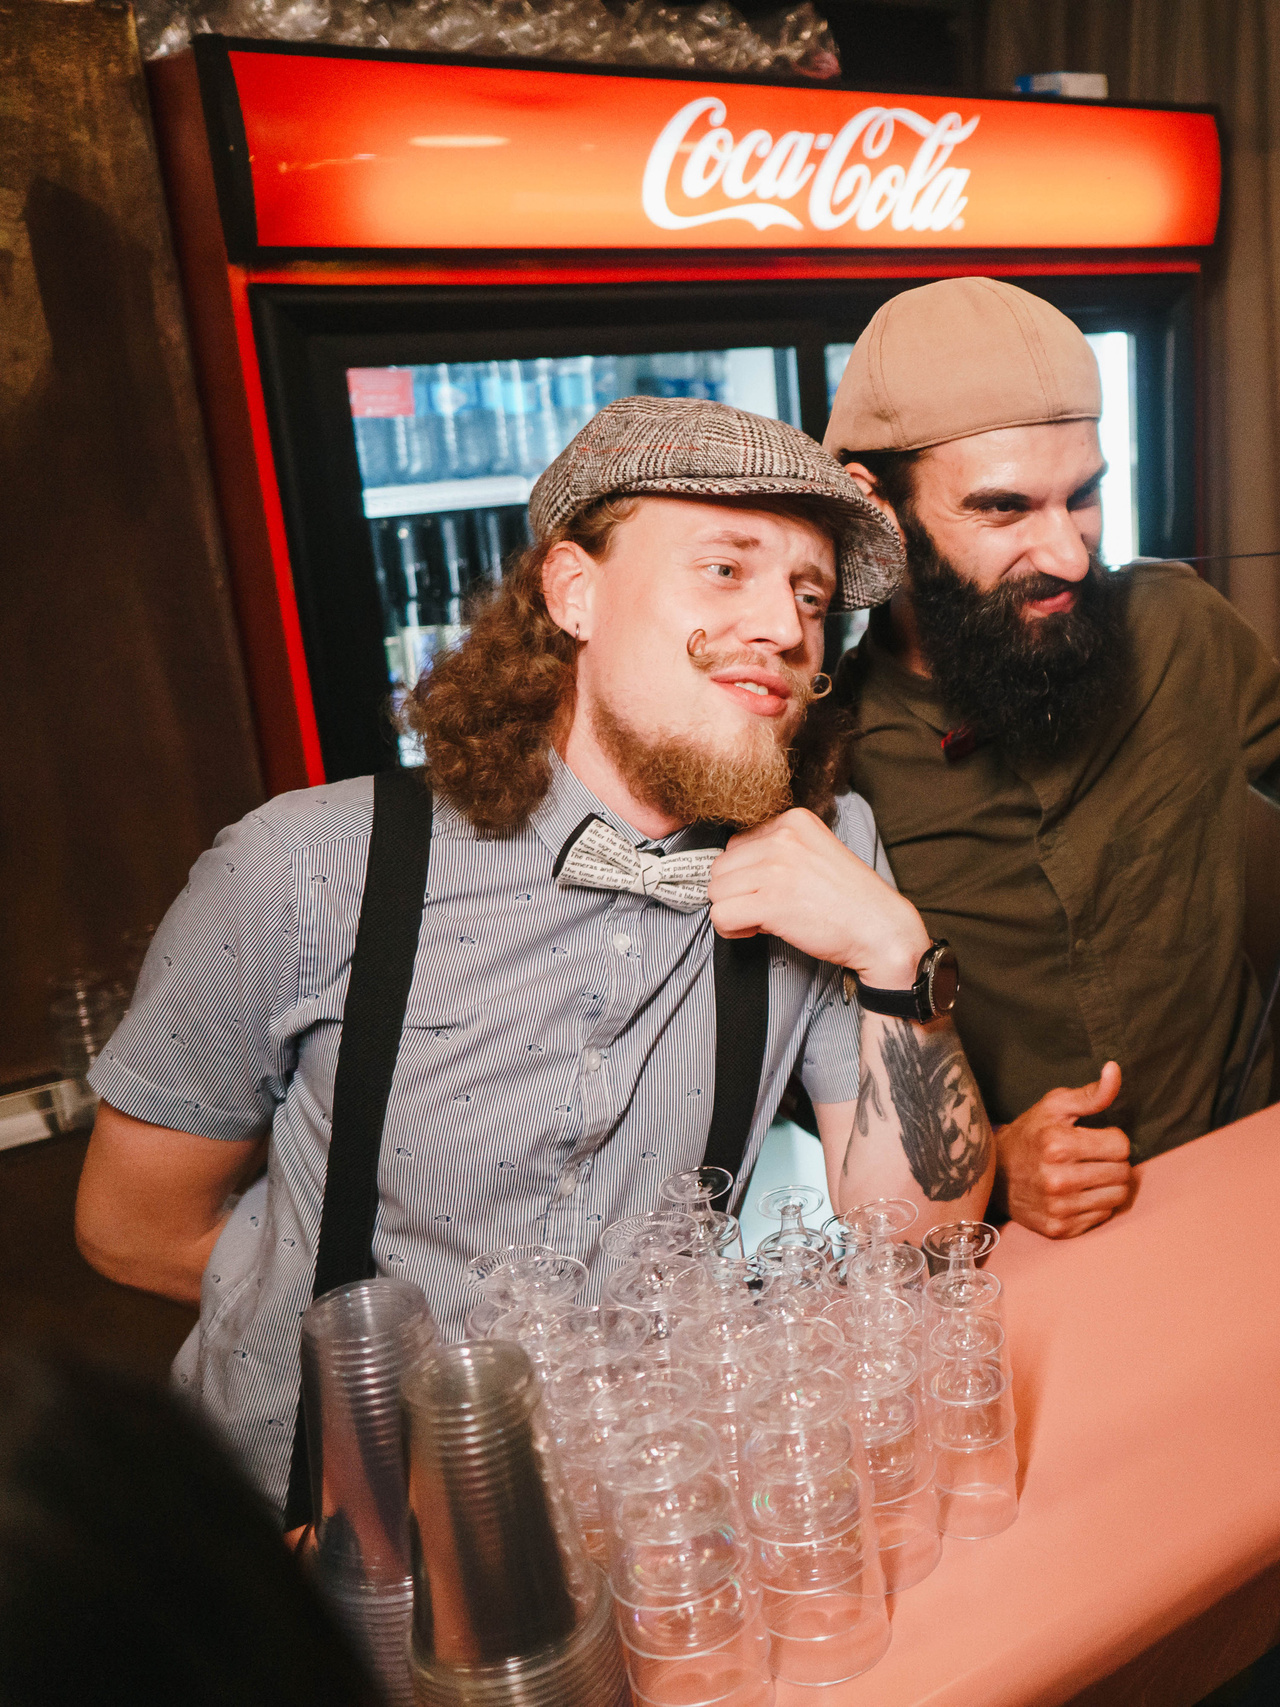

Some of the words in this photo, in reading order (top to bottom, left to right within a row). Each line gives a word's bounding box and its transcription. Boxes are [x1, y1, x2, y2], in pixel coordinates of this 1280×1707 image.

[642, 96, 981, 231] Coca-Cola
[606, 837, 617, 847] the
[571, 851, 583, 859] The
[621, 855, 633, 863] the
[566, 860, 598, 870] cameras
[600, 866, 614, 874] and
[673, 864, 704, 872] paintings
